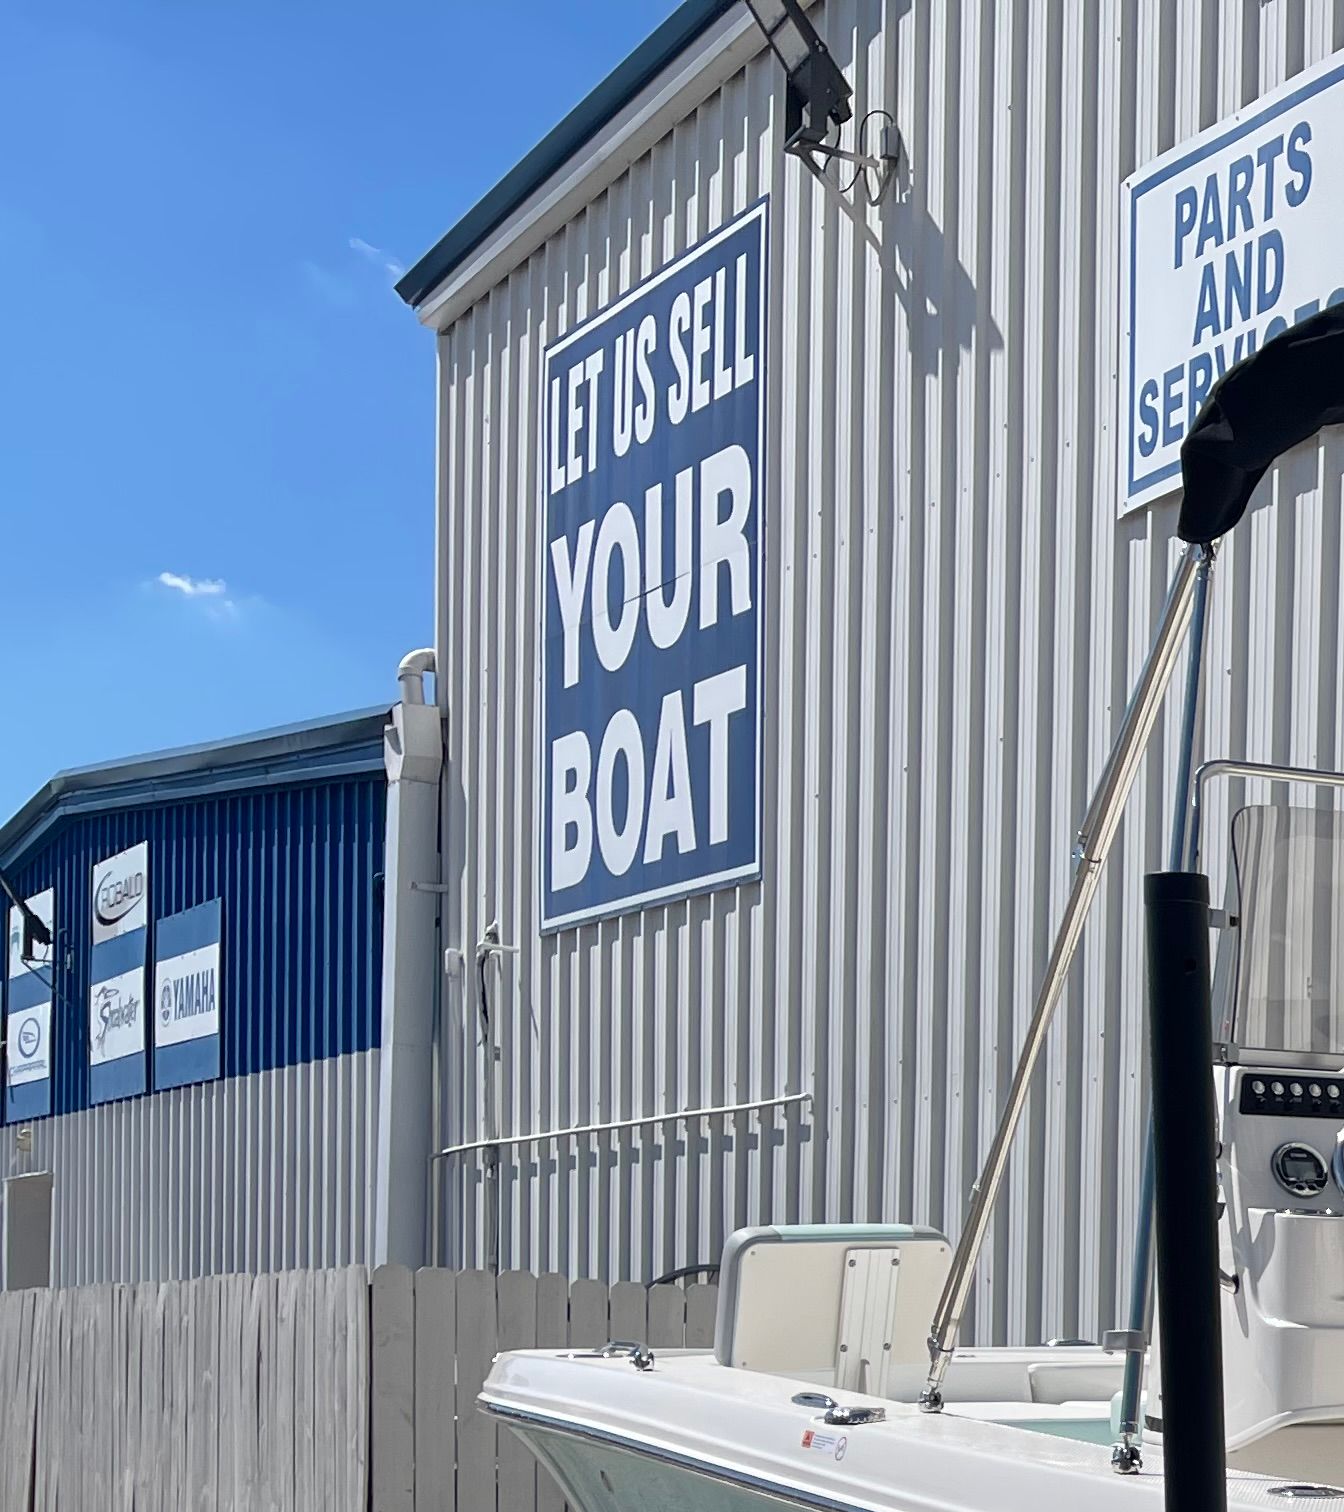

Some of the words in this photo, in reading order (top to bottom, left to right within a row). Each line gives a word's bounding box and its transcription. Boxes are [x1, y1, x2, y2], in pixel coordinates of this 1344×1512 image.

[1174, 120, 1312, 270] PARTS
[1192, 228, 1285, 347] AND
[550, 349, 604, 495] LET
[612, 314, 657, 457] US
[667, 253, 754, 425] SELL
[550, 444, 752, 689] YOUR
[550, 664, 748, 892] BOAT
[173, 968, 216, 1021] YAMAHA
